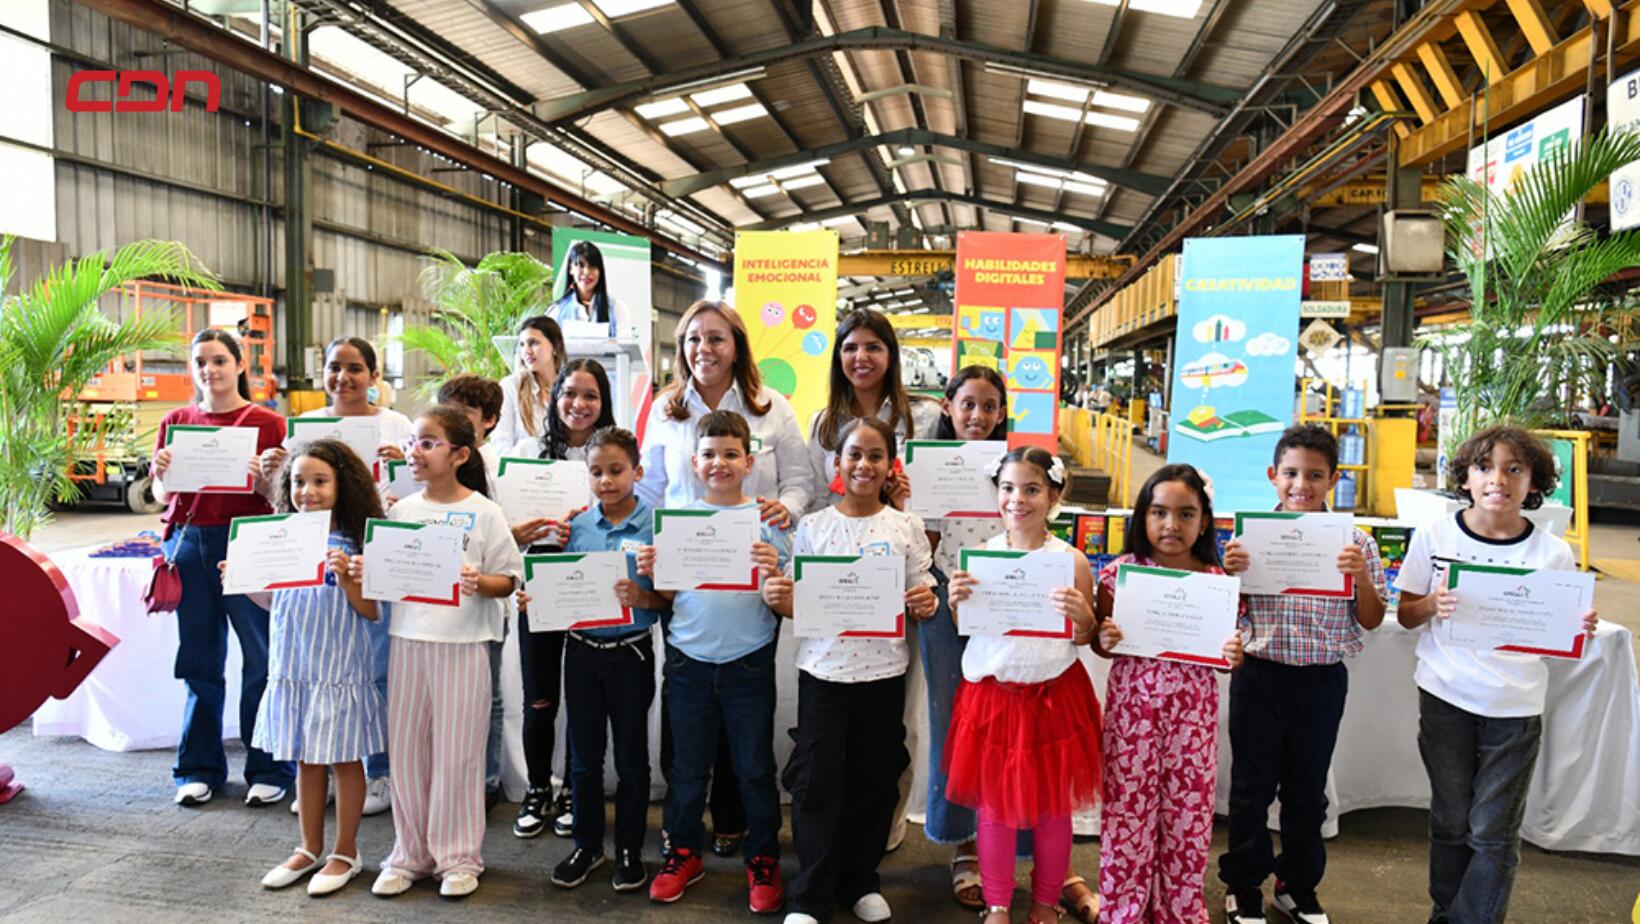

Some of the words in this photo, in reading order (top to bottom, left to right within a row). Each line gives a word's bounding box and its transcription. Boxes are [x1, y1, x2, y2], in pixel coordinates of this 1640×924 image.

[742, 258, 829, 269] INTELIGENCIA
[964, 258, 1057, 272] HABILIDADES
[747, 273, 822, 283] EMOCIONAL
[975, 272, 1045, 285] DIGITALES
[1185, 277, 1297, 292] CREATIVIDAD
[1302, 304, 1348, 314] SOLDADURA
